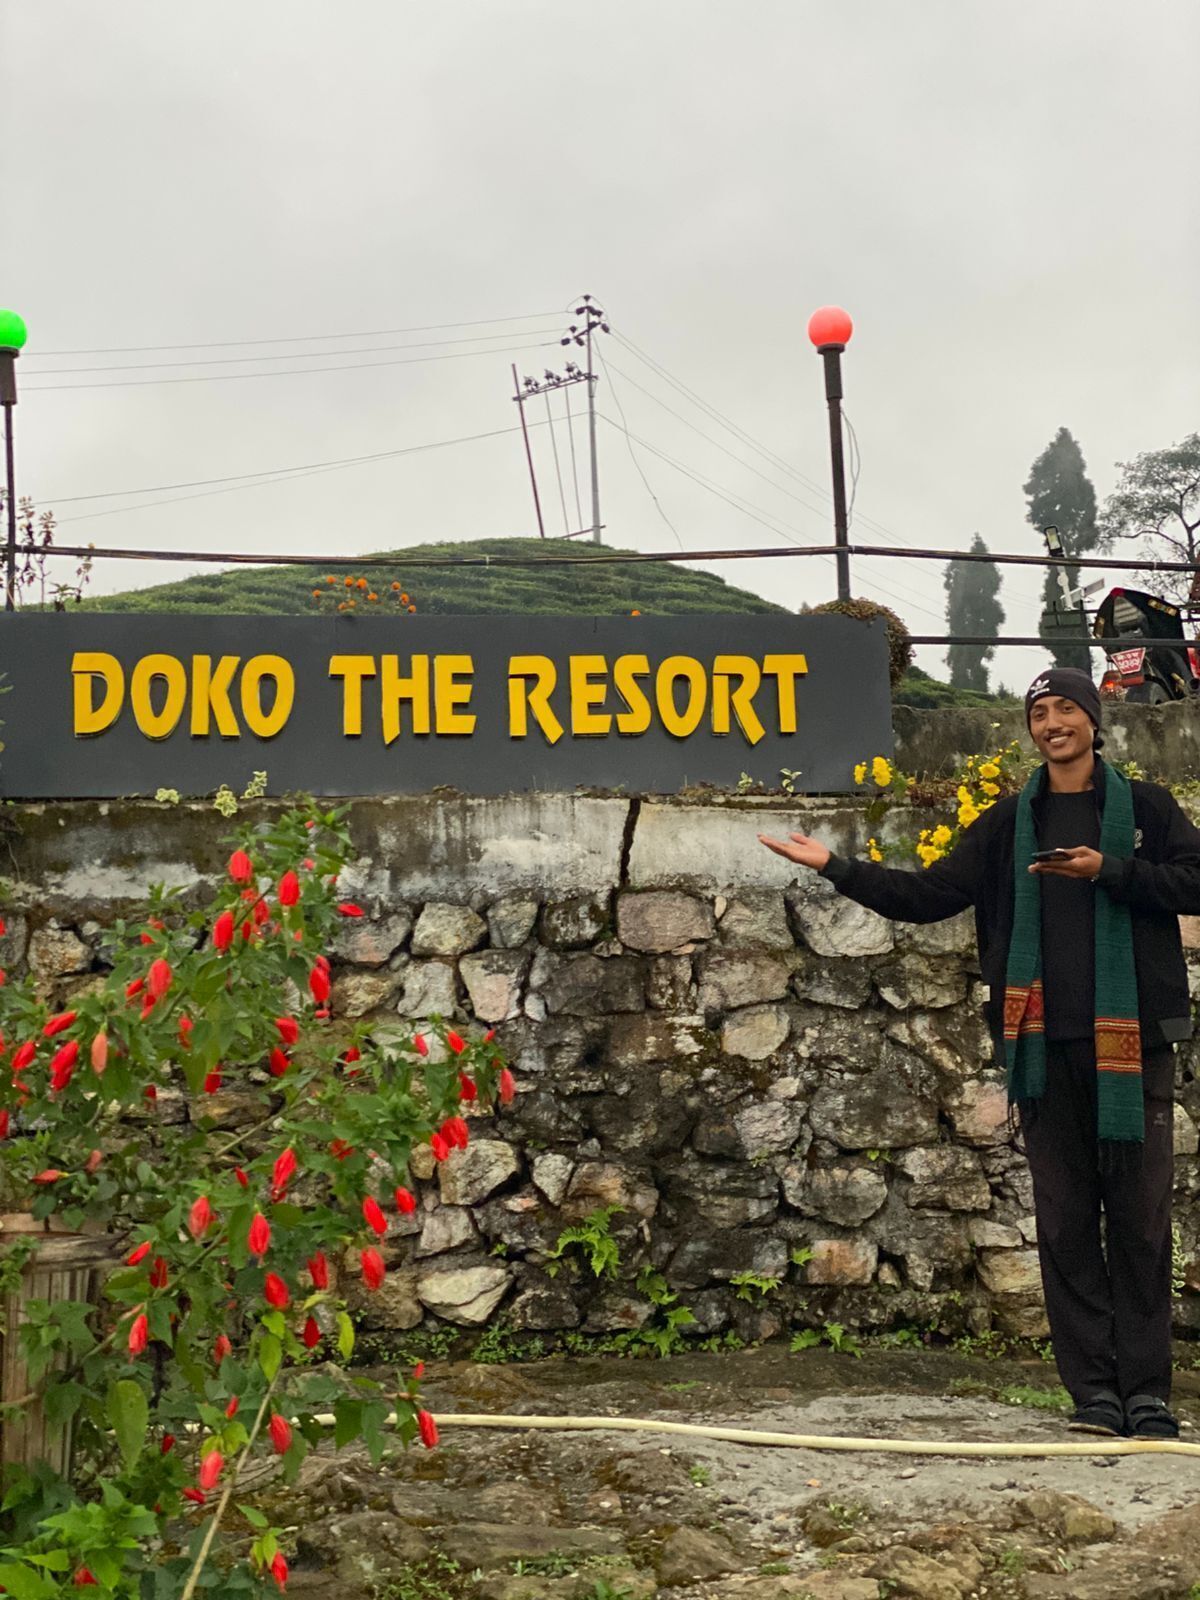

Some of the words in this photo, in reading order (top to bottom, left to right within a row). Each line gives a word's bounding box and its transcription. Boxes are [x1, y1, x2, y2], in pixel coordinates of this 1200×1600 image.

[71, 652, 295, 738] DOKO
[329, 655, 477, 744] THE
[508, 654, 808, 745] RESORT
